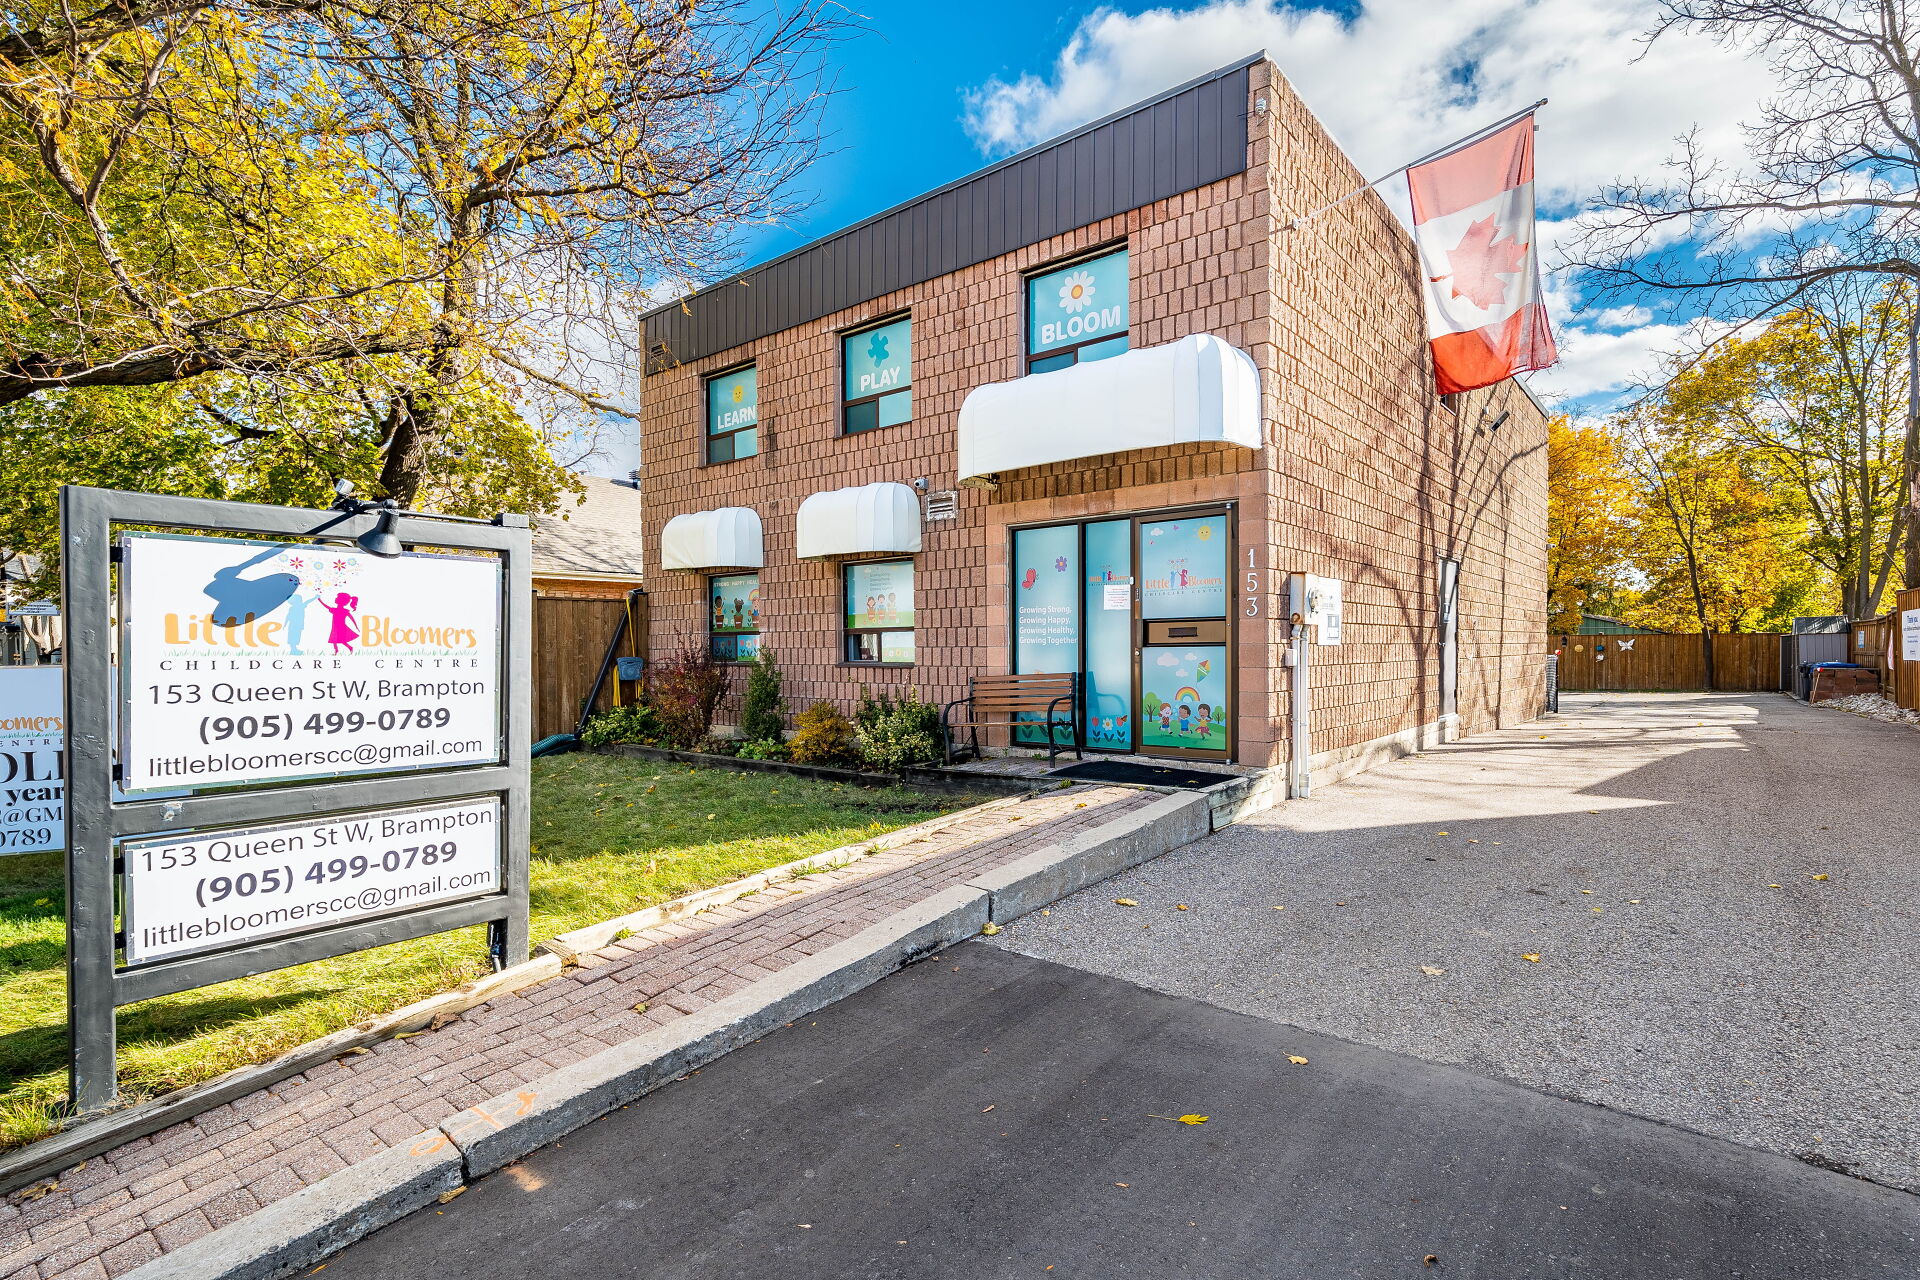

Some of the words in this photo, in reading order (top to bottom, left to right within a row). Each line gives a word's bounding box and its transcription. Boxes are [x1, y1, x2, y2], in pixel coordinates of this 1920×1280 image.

[1041, 305, 1121, 345] BLOOM
[860, 366, 900, 392] PLAY
[717, 405, 757, 430] LEARN
[1246, 548, 1258, 617] 153
[1019, 606, 1047, 615] Growing
[1047, 605, 1073, 614] Strong,
[1019, 616, 1047, 625] Growing
[164, 612, 283, 648] Little
[361, 615, 477, 649] Bloomers
[1019, 626, 1047, 635] Growing
[1019, 636, 1047, 645] Growing
[159, 659, 341, 671] CHILDCARE
[375, 658, 478, 669] CENTRE
[149, 684, 201, 704] 153
[211, 683, 303, 704] Queen
[312, 681, 337, 699] St
[342, 680, 370, 700] W,
[378, 679, 484, 700] Brampton
[199, 713, 293, 745] (905)
[303, 707, 451, 735] 499-0789
[149, 739, 482, 777] littlebloomerscc@gmail.com
[142, 846, 197, 871] 153
[208, 834, 303, 863] Queen
[313, 827, 338, 848] St
[344, 822, 373, 843] W,
[382, 809, 492, 838] Brampton
[196, 865, 293, 908] (905)
[305, 841, 457, 885] 499-0789
[143, 869, 490, 948] littlebloomerscc@gmail.com
